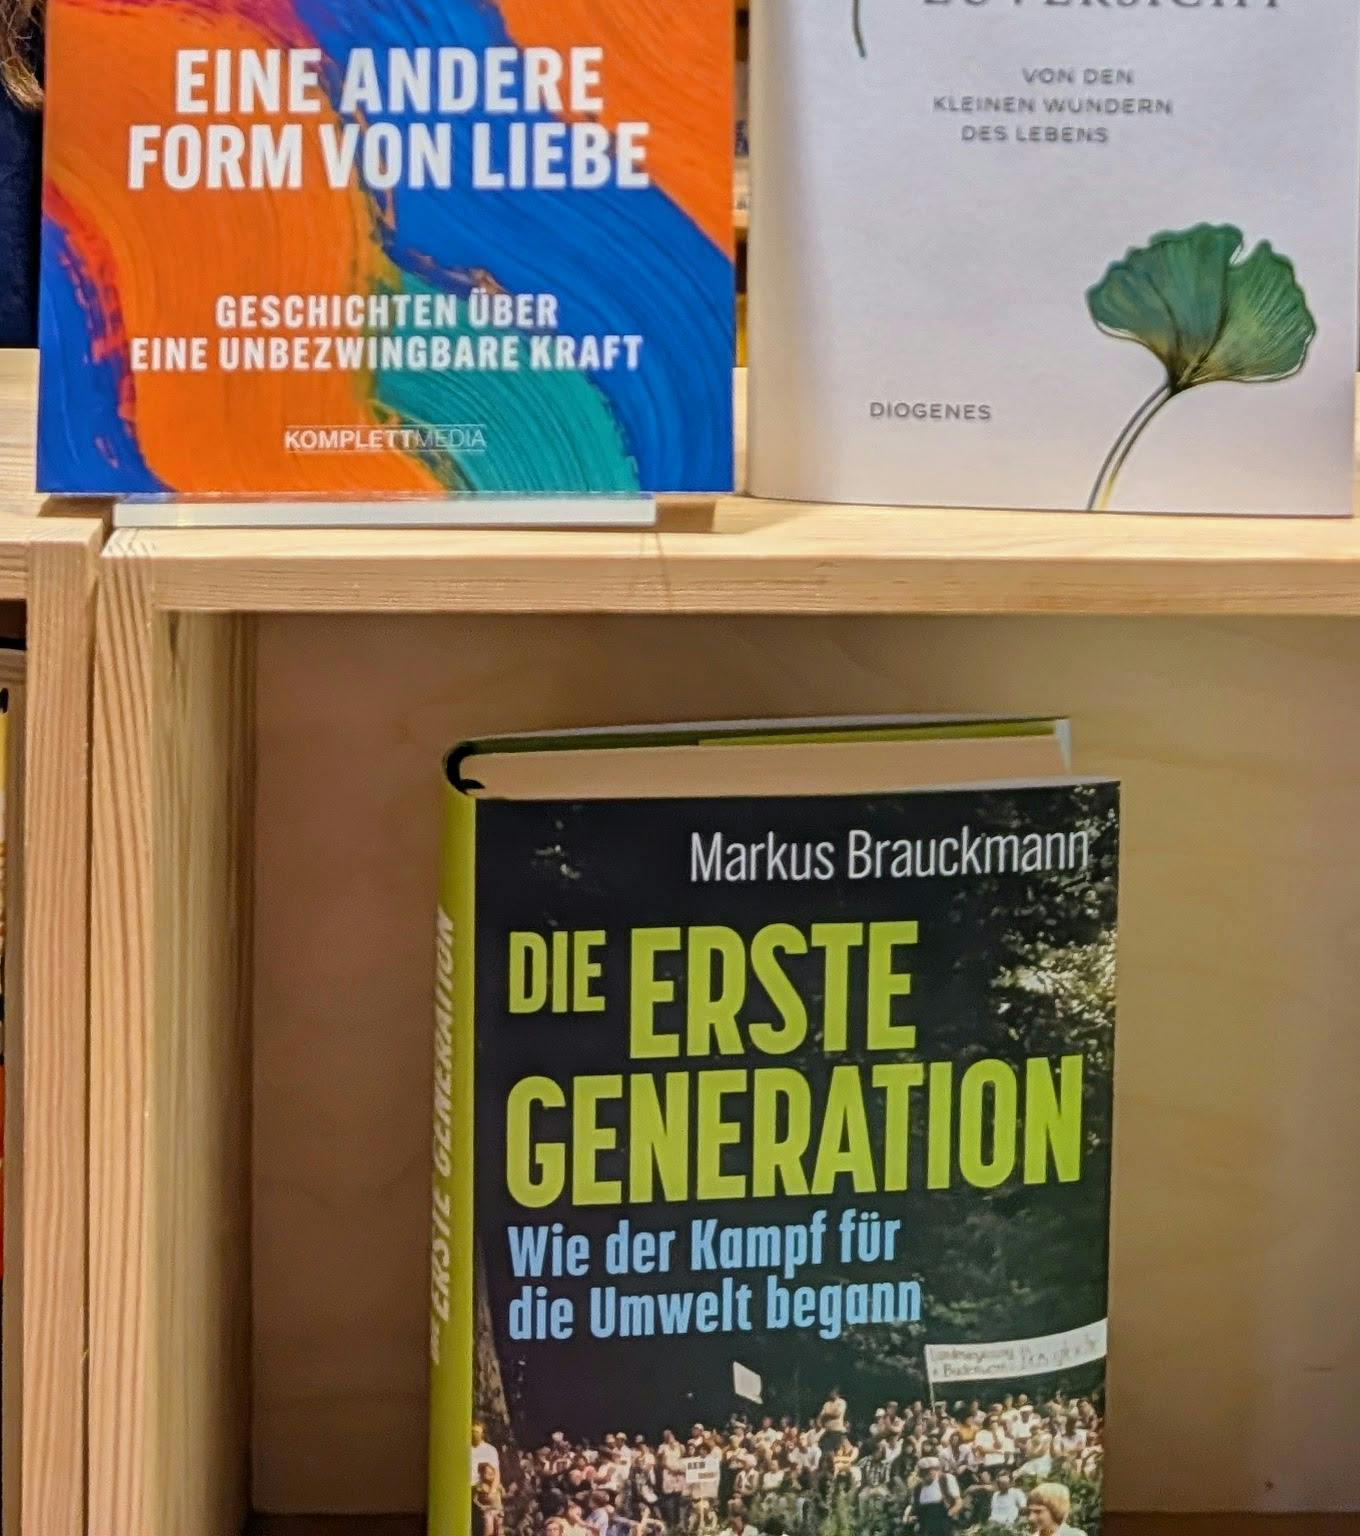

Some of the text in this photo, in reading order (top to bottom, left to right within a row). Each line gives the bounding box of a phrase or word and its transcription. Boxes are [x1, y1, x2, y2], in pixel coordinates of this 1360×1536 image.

[176, 46, 605, 114] EINE ANDERE
[933, 95, 1173, 116] KLEINEN WUNDERN
[1022, 67, 1134, 86] VON DEN
[128, 120, 650, 191] FORM VON LIEBE
[961, 124, 1109, 144] DES LEBENS
[215, 286, 559, 330] GESCHICHTEN ÜBER
[130, 334, 644, 372] EINE UNBEZWINGBARE KRAFT
[869, 402, 992, 421] DIOGENES
[689, 825, 1091, 884] Markus Brauckmann
[508, 920, 919, 1059] DIE ERSTE
[506, 1054, 1084, 1209] GENERATION
[507, 1207, 903, 1280] Wie der Kampf für
[507, 1277, 922, 1342] die Umwelt begann
